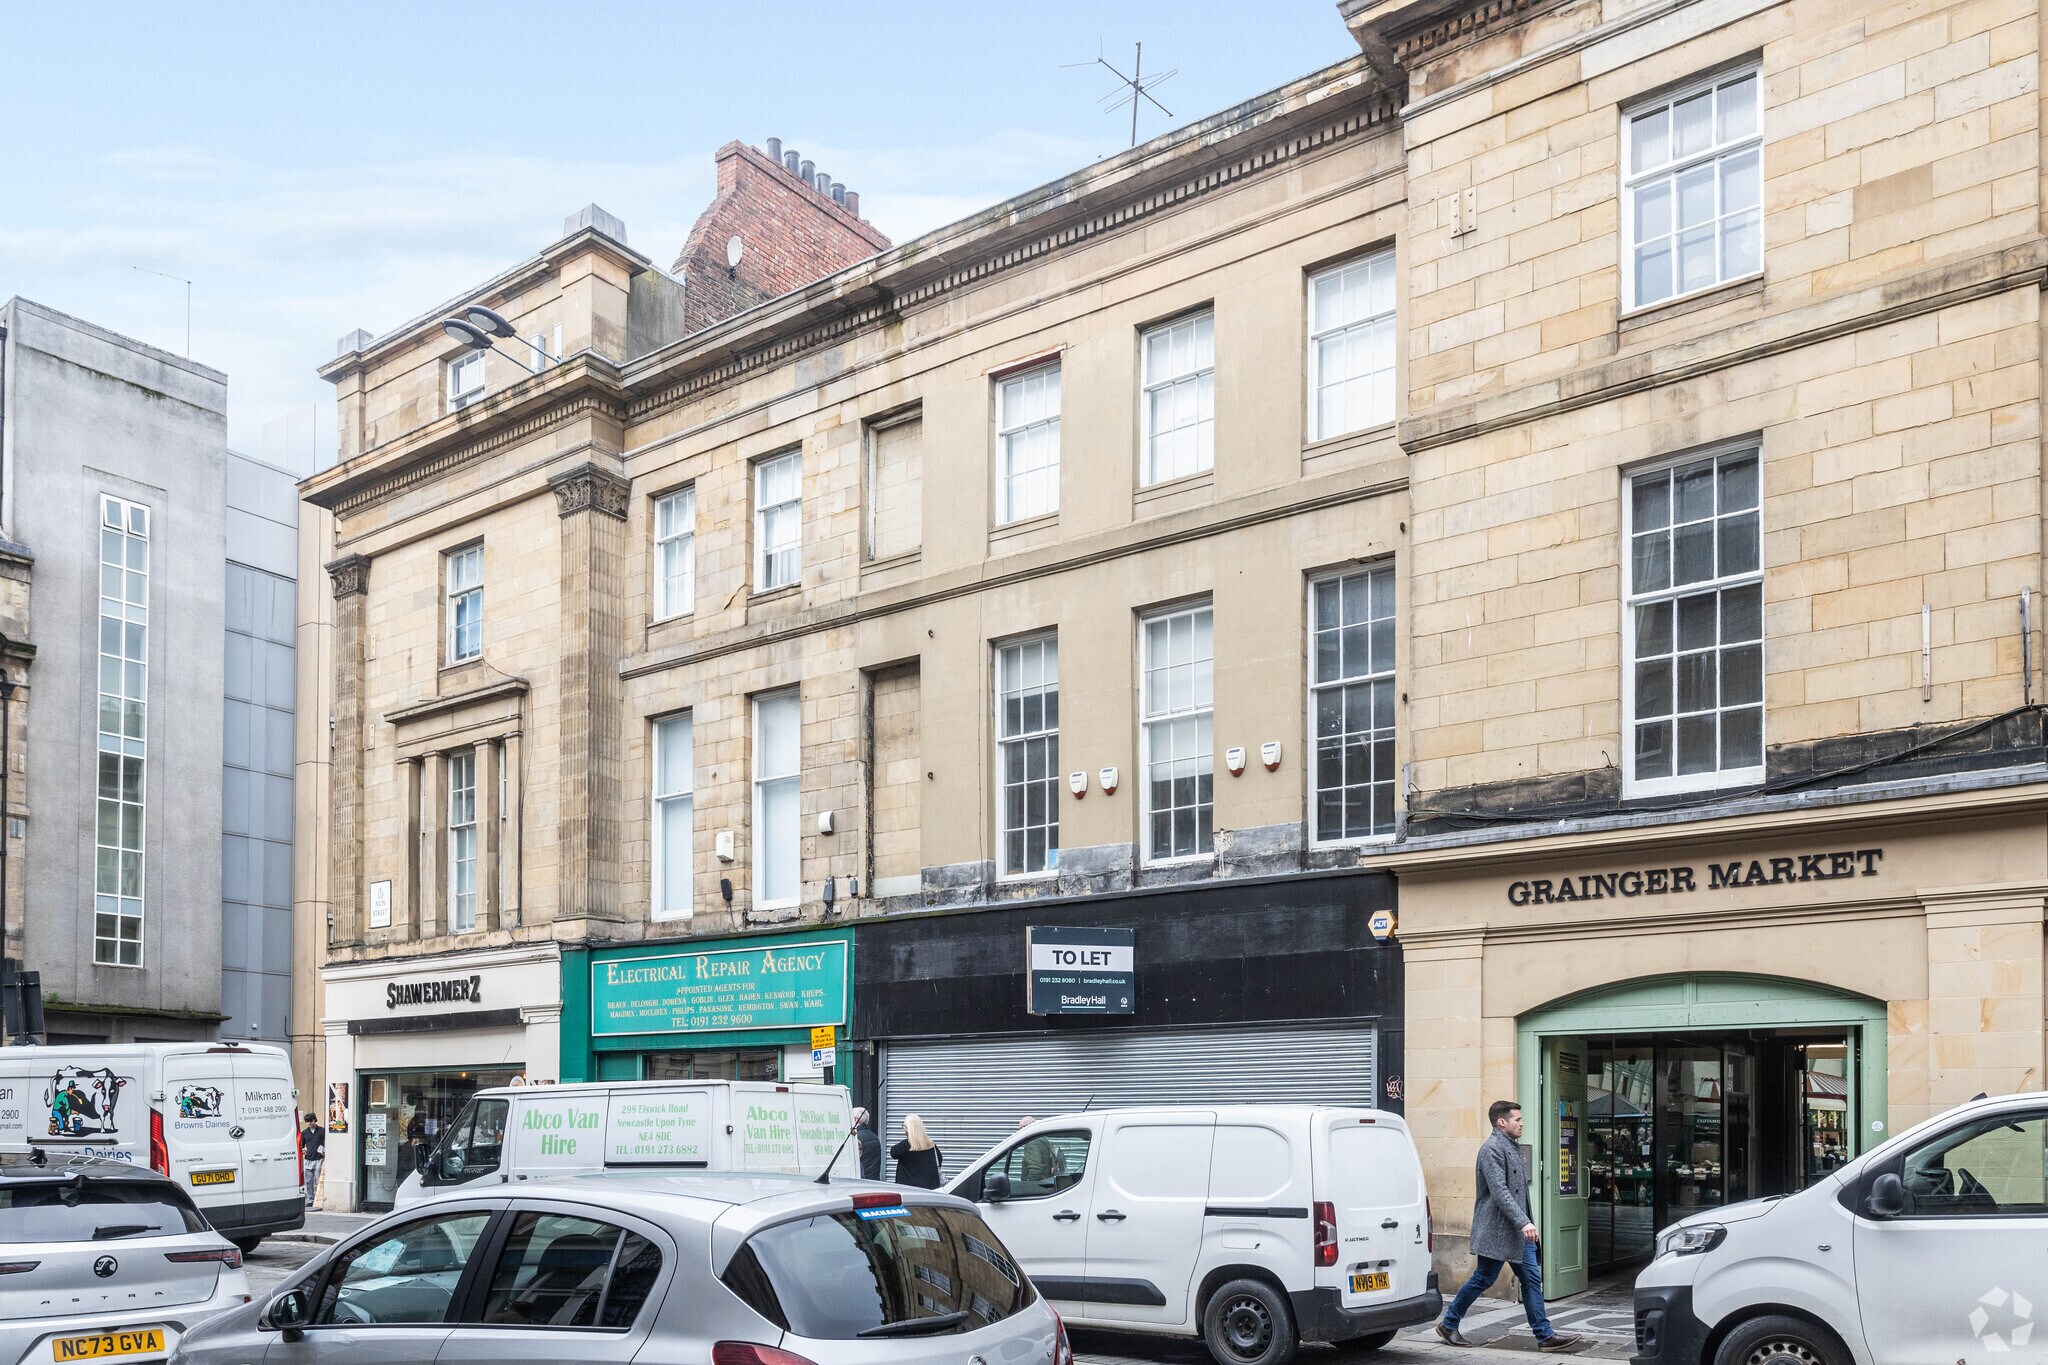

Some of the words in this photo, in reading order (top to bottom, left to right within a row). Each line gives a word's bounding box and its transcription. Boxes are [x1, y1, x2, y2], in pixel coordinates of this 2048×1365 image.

[1507, 866, 1696, 907] GRAINGER
[1708, 848, 1882, 890] MARKET
[1374, 920, 1387, 928] ADT
[1052, 950, 1077, 965] TO
[1080, 951, 1112, 966] LET
[606, 963, 686, 986] ELECTRICAL
[695, 955, 750, 979] REPAIR
[760, 950, 826, 974] AGENCY
[1083, 977, 1126, 985] bradleyhall.co.uk
[386, 974, 481, 1009] SHAWERMERZ
[676, 985, 713, 995] APPOINTED
[714, 983, 742, 993] AGENTS
[742, 982, 756, 991] FOR
[607, 1001, 627, 1009] BRAUN
[630, 999, 659, 1008] DELONGHI
[662, 997, 687, 1006] DOMENA
[691, 995, 714, 1004] GOBLIN
[717, 994, 735, 1003] GLEN
[739, 992, 761, 1001] HADEN
[764, 990, 796, 1000] KENWOOD
[801, 989, 824, 998] KRUPS
[610, 1010, 635, 1019] MAGIMIX
[639, 1008, 668, 1017] MOULINEX
[672, 1006, 695, 1015] PHILIPS
[699, 1004, 734, 1014] PANASONIC
[738, 1002, 775, 1012] REMINGTON
[780, 1000, 799, 1009] SWAN
[803, 999, 824, 1008] WAHL
[671, 1017, 689, 1027] TEL:
[690, 1016, 709, 1028] 0191
[712, 1015, 729, 1025] 232
[730, 1014, 753, 1026] 9600
[245, 1091, 282, 1102] Milkman
[1, 1109, 20, 1120] 2900
[248, 1106, 262, 1114] 0191
[264, 1105, 274, 1113] 488
[275, 1105, 288, 1113] 2900
[621, 1104, 637, 1114] 298
[638, 1104, 667, 1114] Elswick
[668, 1103, 689, 1113] Road
[747, 1105, 788, 1121] Abco
[174, 1121, 204, 1130] Browns
[205, 1120, 231, 1129] Dairies
[522, 1109, 563, 1130] Abco
[568, 1108, 599, 1129] Van
[616, 1118, 654, 1128] Newcastle
[655, 1118, 676, 1129] Upon
[677, 1117, 696, 1129] Tyne
[639, 1132, 653, 1141] NE4
[655, 1131, 672, 1141] 8DE
[746, 1124, 767, 1139] Van
[769, 1124, 791, 1140] Hire
[799, 1127, 823, 1140] Newcastle
[541, 1134, 577, 1155] Hire
[635, 1145, 655, 1155] 0191
[657, 1145, 674, 1155] 273
[675, 1144, 698, 1155] 6882
[758, 1144, 771, 1154] 0191
[771, 1144, 781, 1154] 273
[196, 1173, 214, 1183] GU71
[1373, 1273, 1388, 1288] YHX
[40, 1291, 164, 1305] ASTRA
[61, 1336, 114, 1358] NC73
[119, 1332, 157, 1351] GVA
